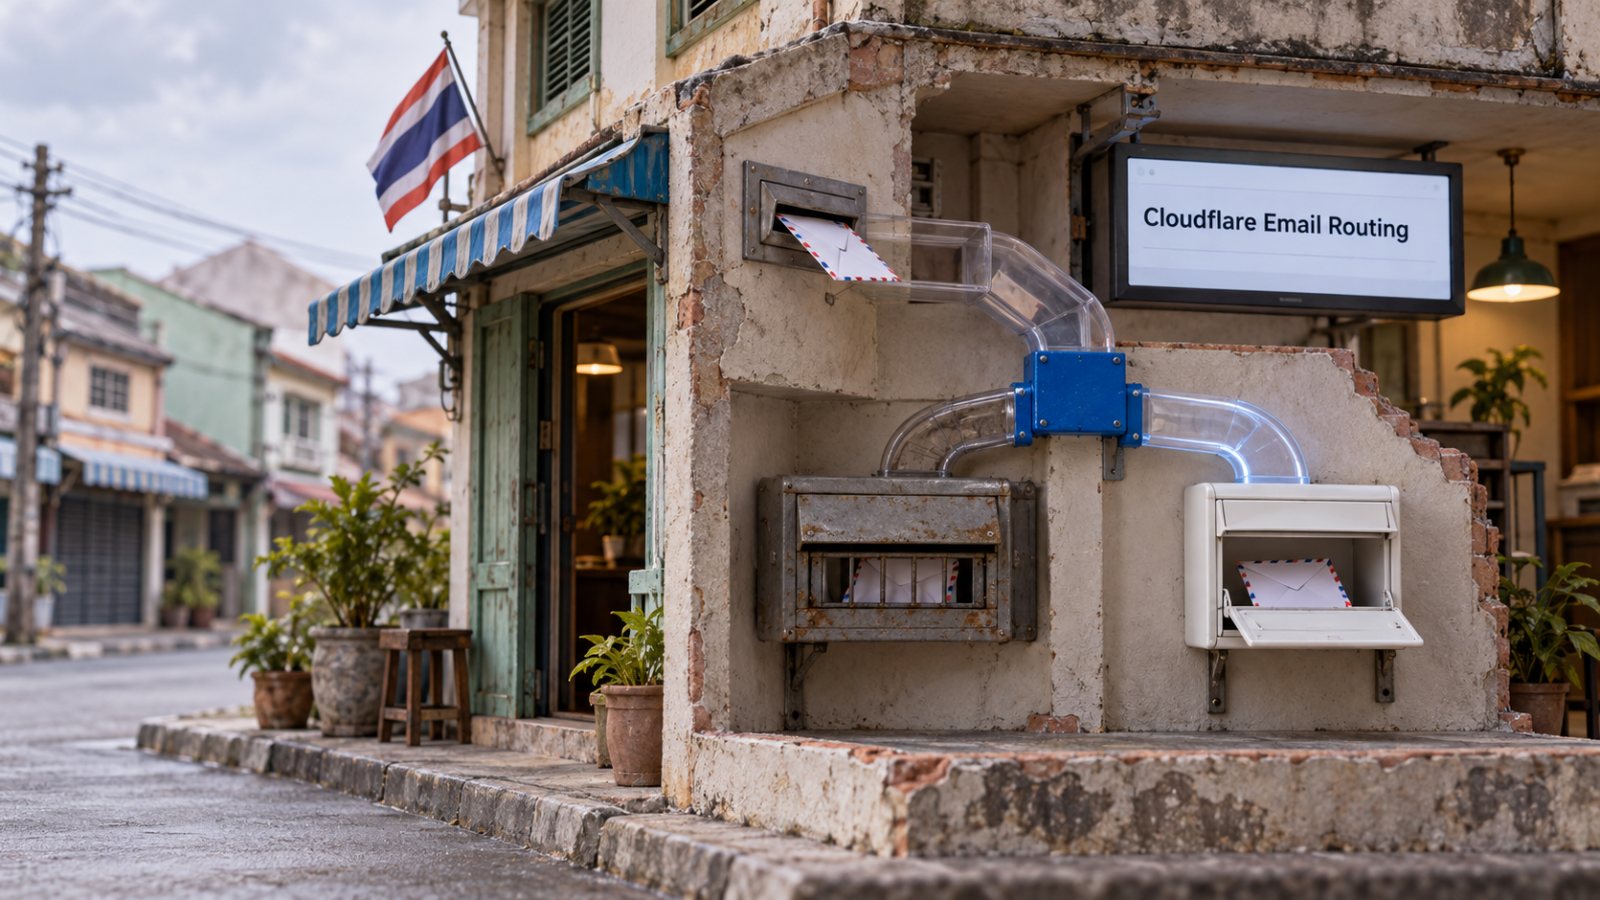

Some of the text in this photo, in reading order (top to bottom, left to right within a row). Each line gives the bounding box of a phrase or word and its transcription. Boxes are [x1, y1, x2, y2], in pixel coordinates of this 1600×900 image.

[1143, 206, 1409, 244] Cloudflare Email Routing
